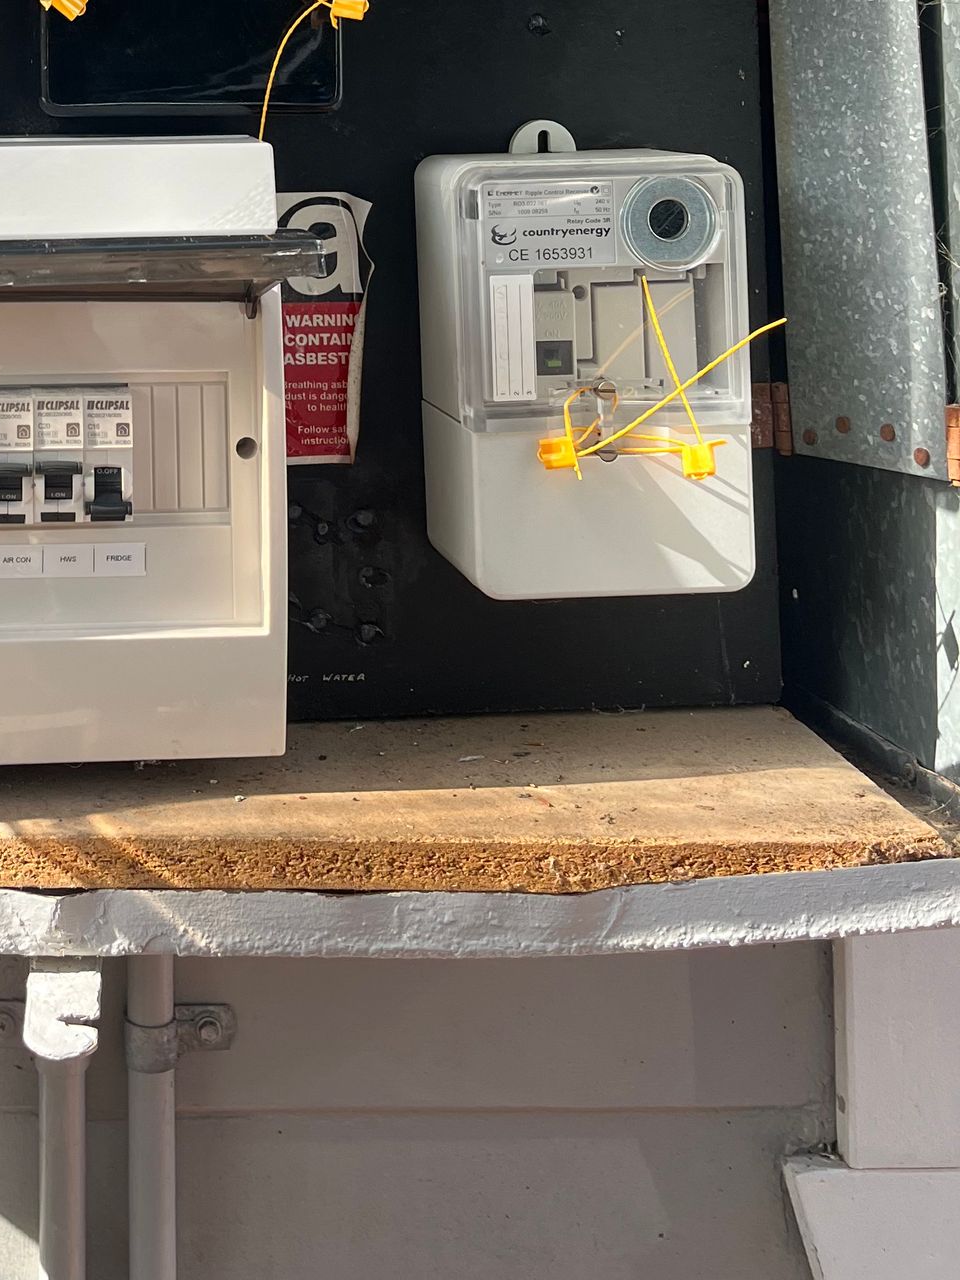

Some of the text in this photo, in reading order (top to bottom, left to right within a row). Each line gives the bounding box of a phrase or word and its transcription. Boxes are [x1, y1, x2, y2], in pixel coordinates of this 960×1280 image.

[523, 227, 610, 238] countryenergy
[509, 247, 592, 261] CE 1653931
[309, 392, 317, 400] is
[45, 401, 80, 410] CLIPSAL
[95, 401, 129, 410] CLIPSAL
[298, 426, 329, 434] Follow
[323, 673, 365, 681] WATER
